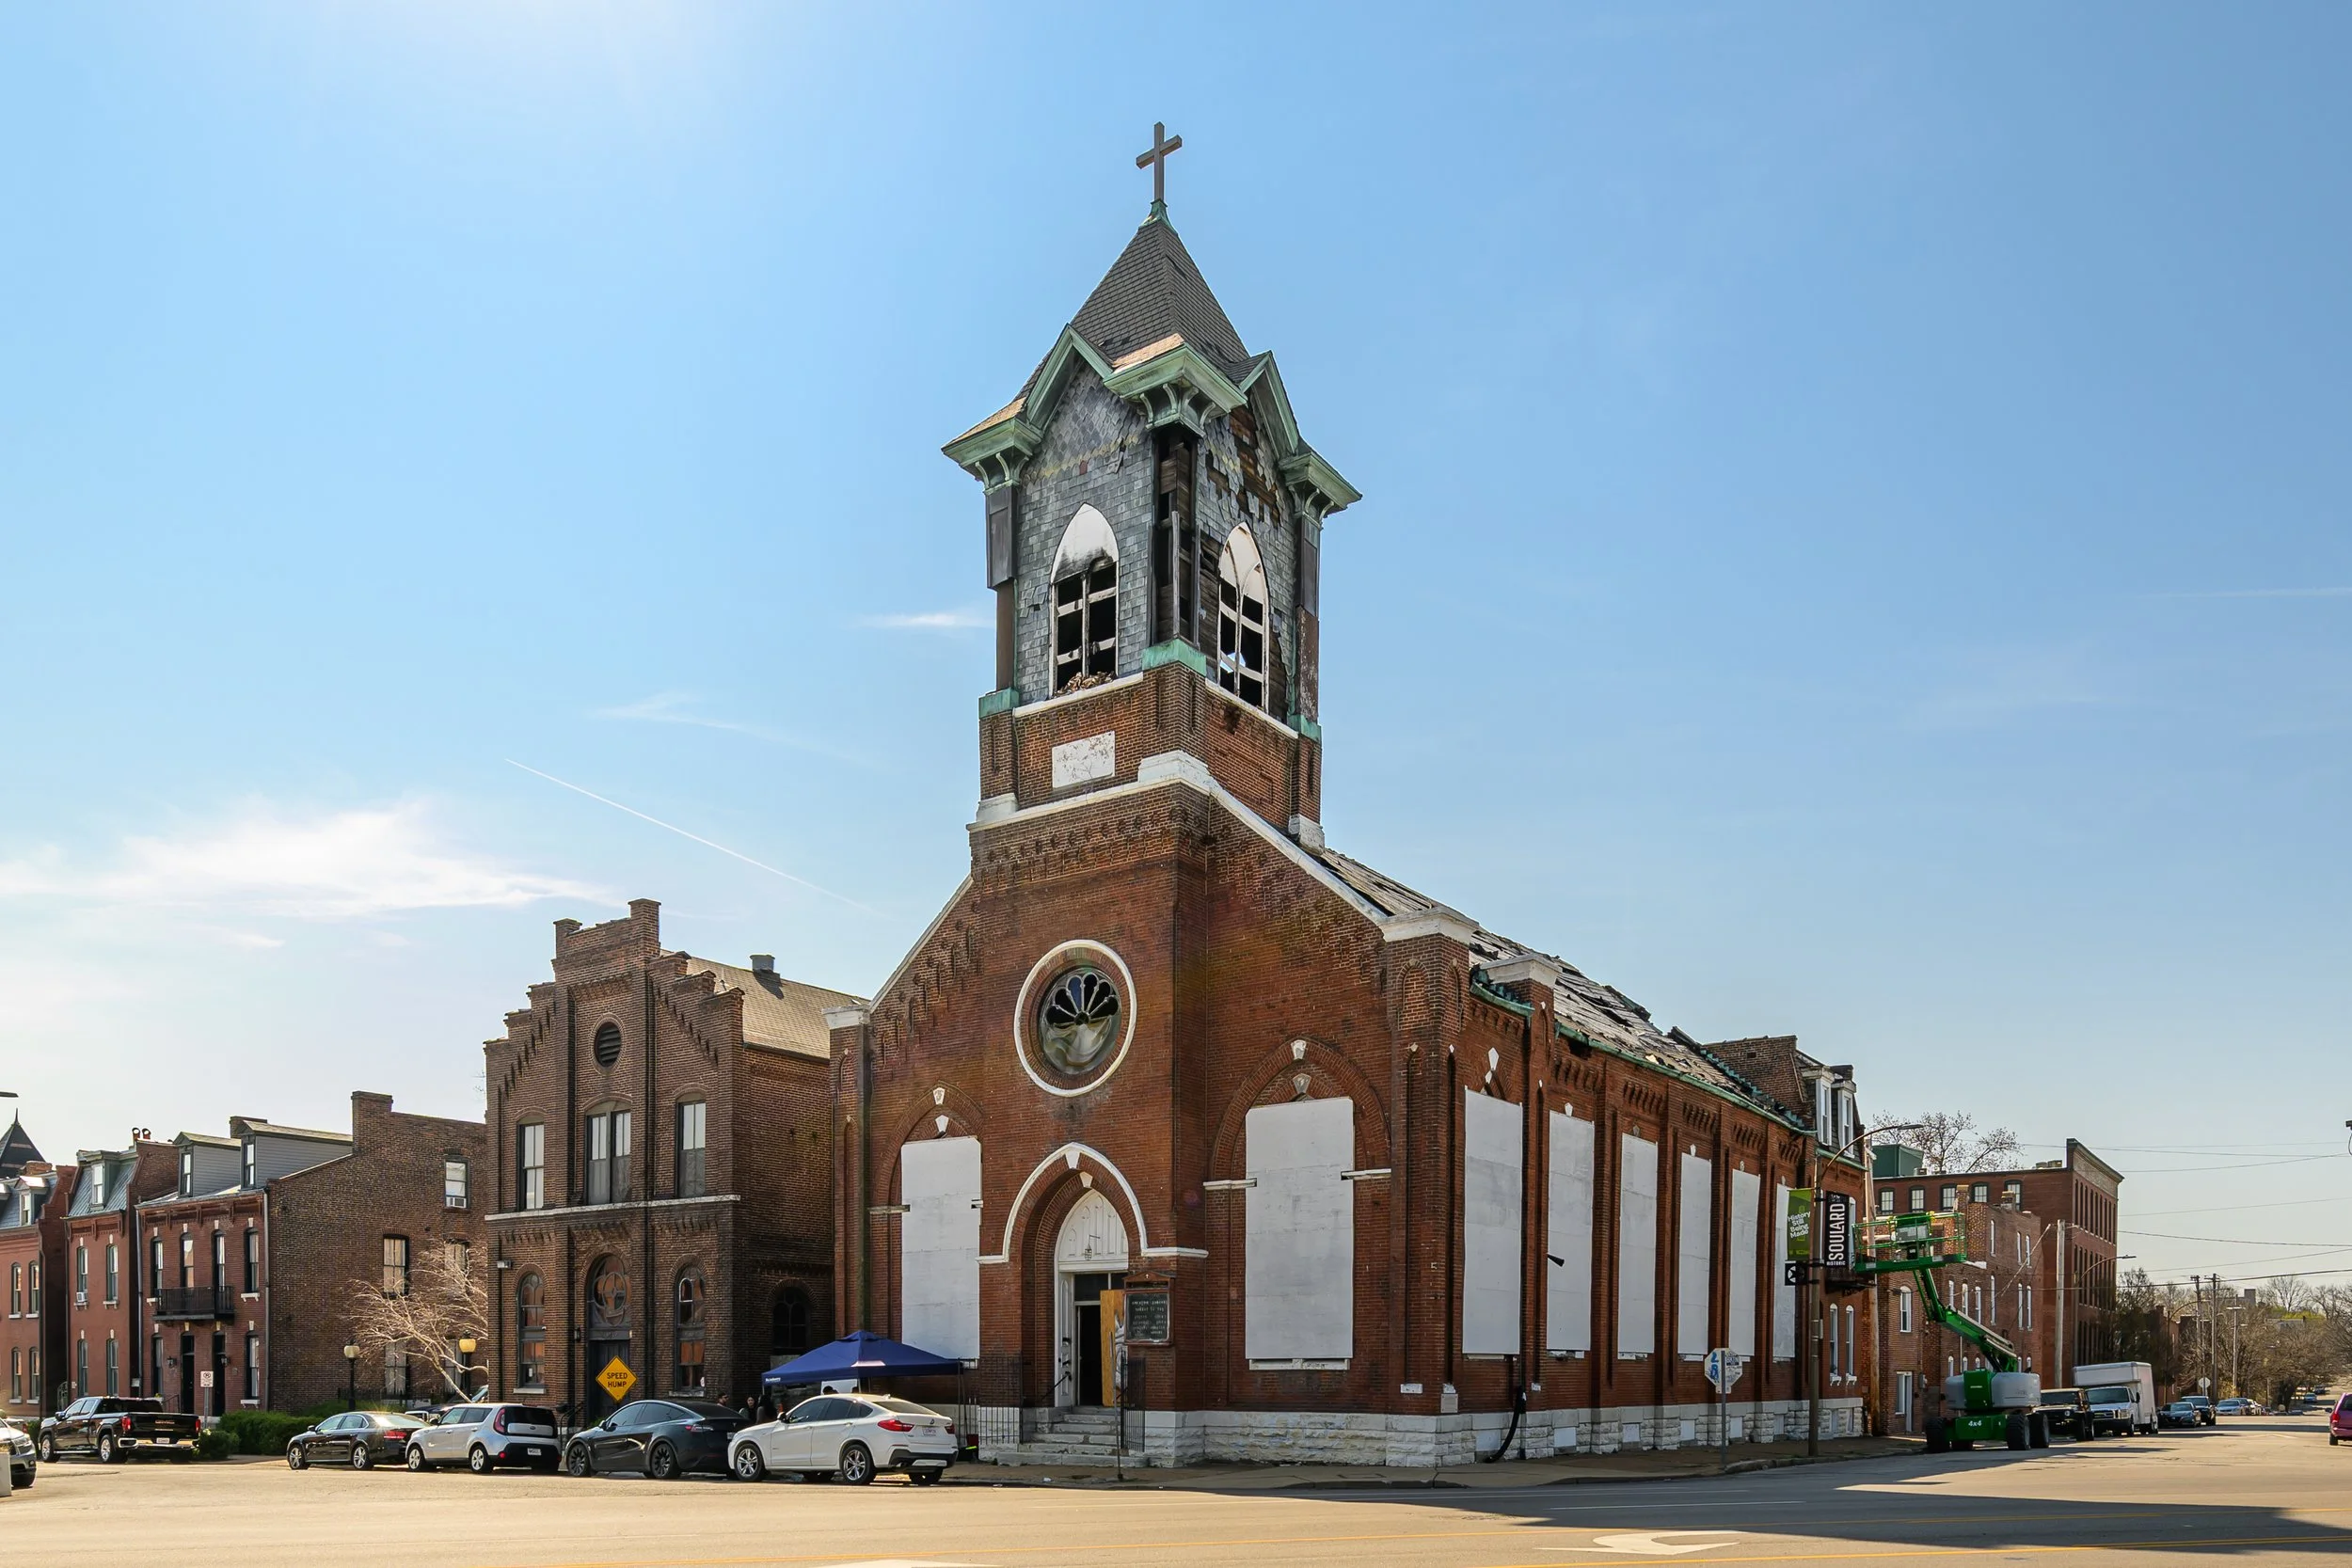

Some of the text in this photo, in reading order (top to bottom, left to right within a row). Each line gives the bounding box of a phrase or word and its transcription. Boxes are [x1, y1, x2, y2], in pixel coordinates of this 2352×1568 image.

[1788, 1212, 1811, 1222] History
[1791, 1217, 1804, 1227] Still
[1789, 1223, 1809, 1232] Being
[1828, 1203, 1846, 1260] SOULARD
[1789, 1228, 1809, 1239] Made
